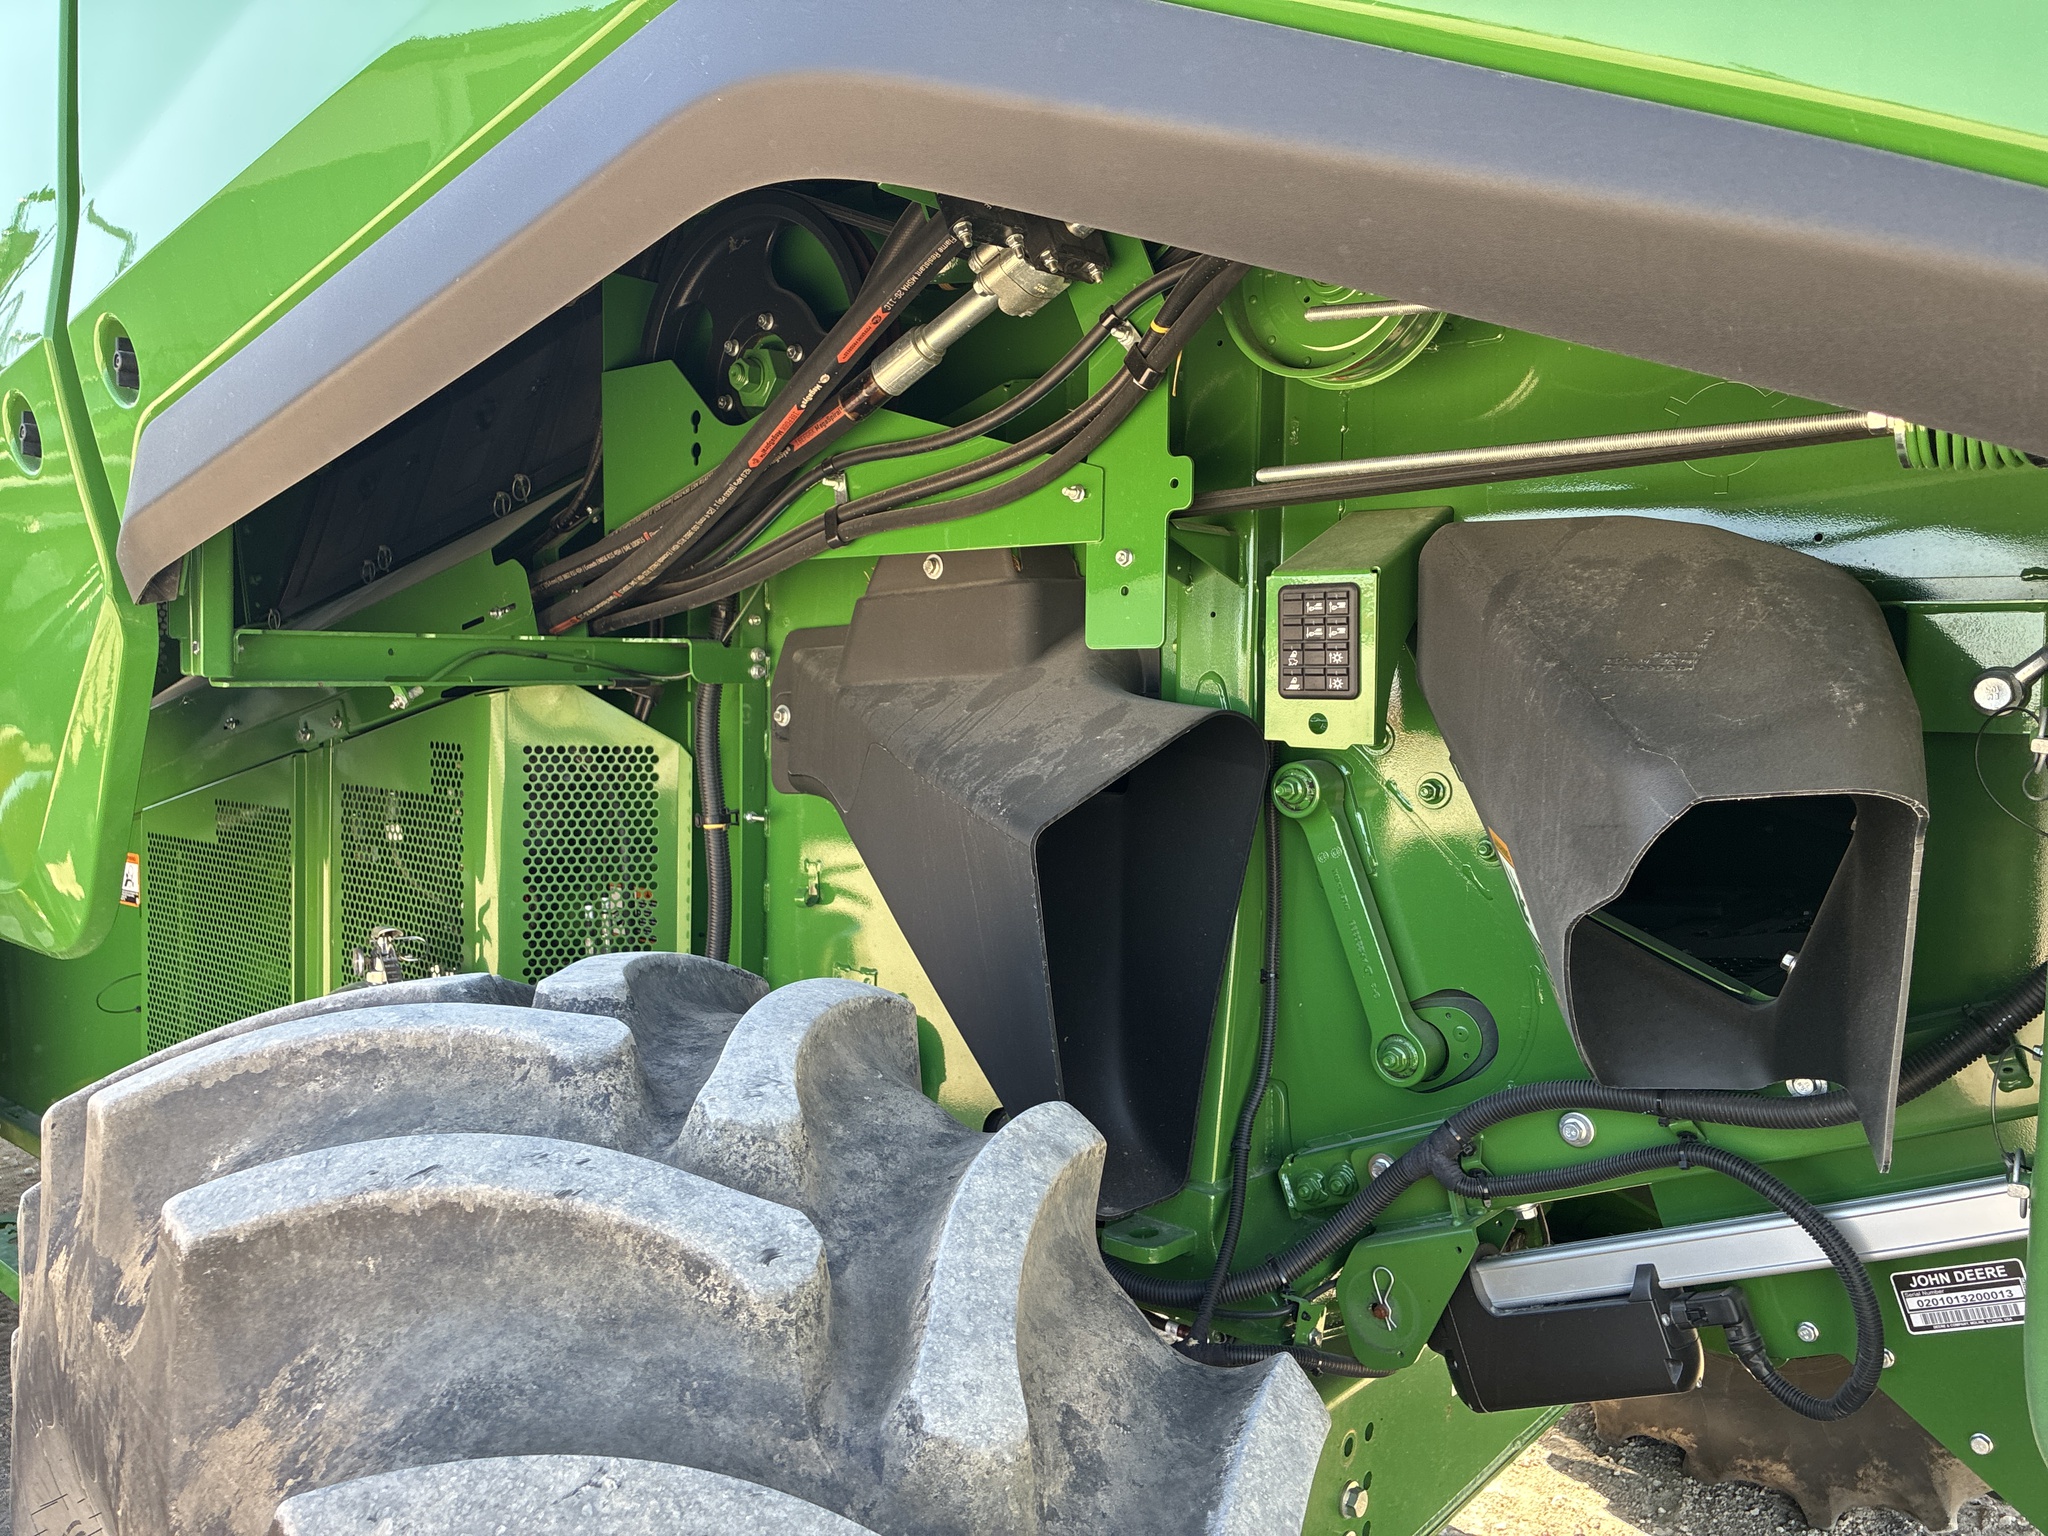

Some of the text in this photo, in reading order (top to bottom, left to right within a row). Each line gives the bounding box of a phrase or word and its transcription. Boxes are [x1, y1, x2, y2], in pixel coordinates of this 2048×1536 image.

[883, 235, 957, 310] Flame Resistant MSHA 2G-11C
[1909, 1265, 2008, 1288] JOHN DEERE
[1917, 1289, 2014, 1308] 0201013200013
